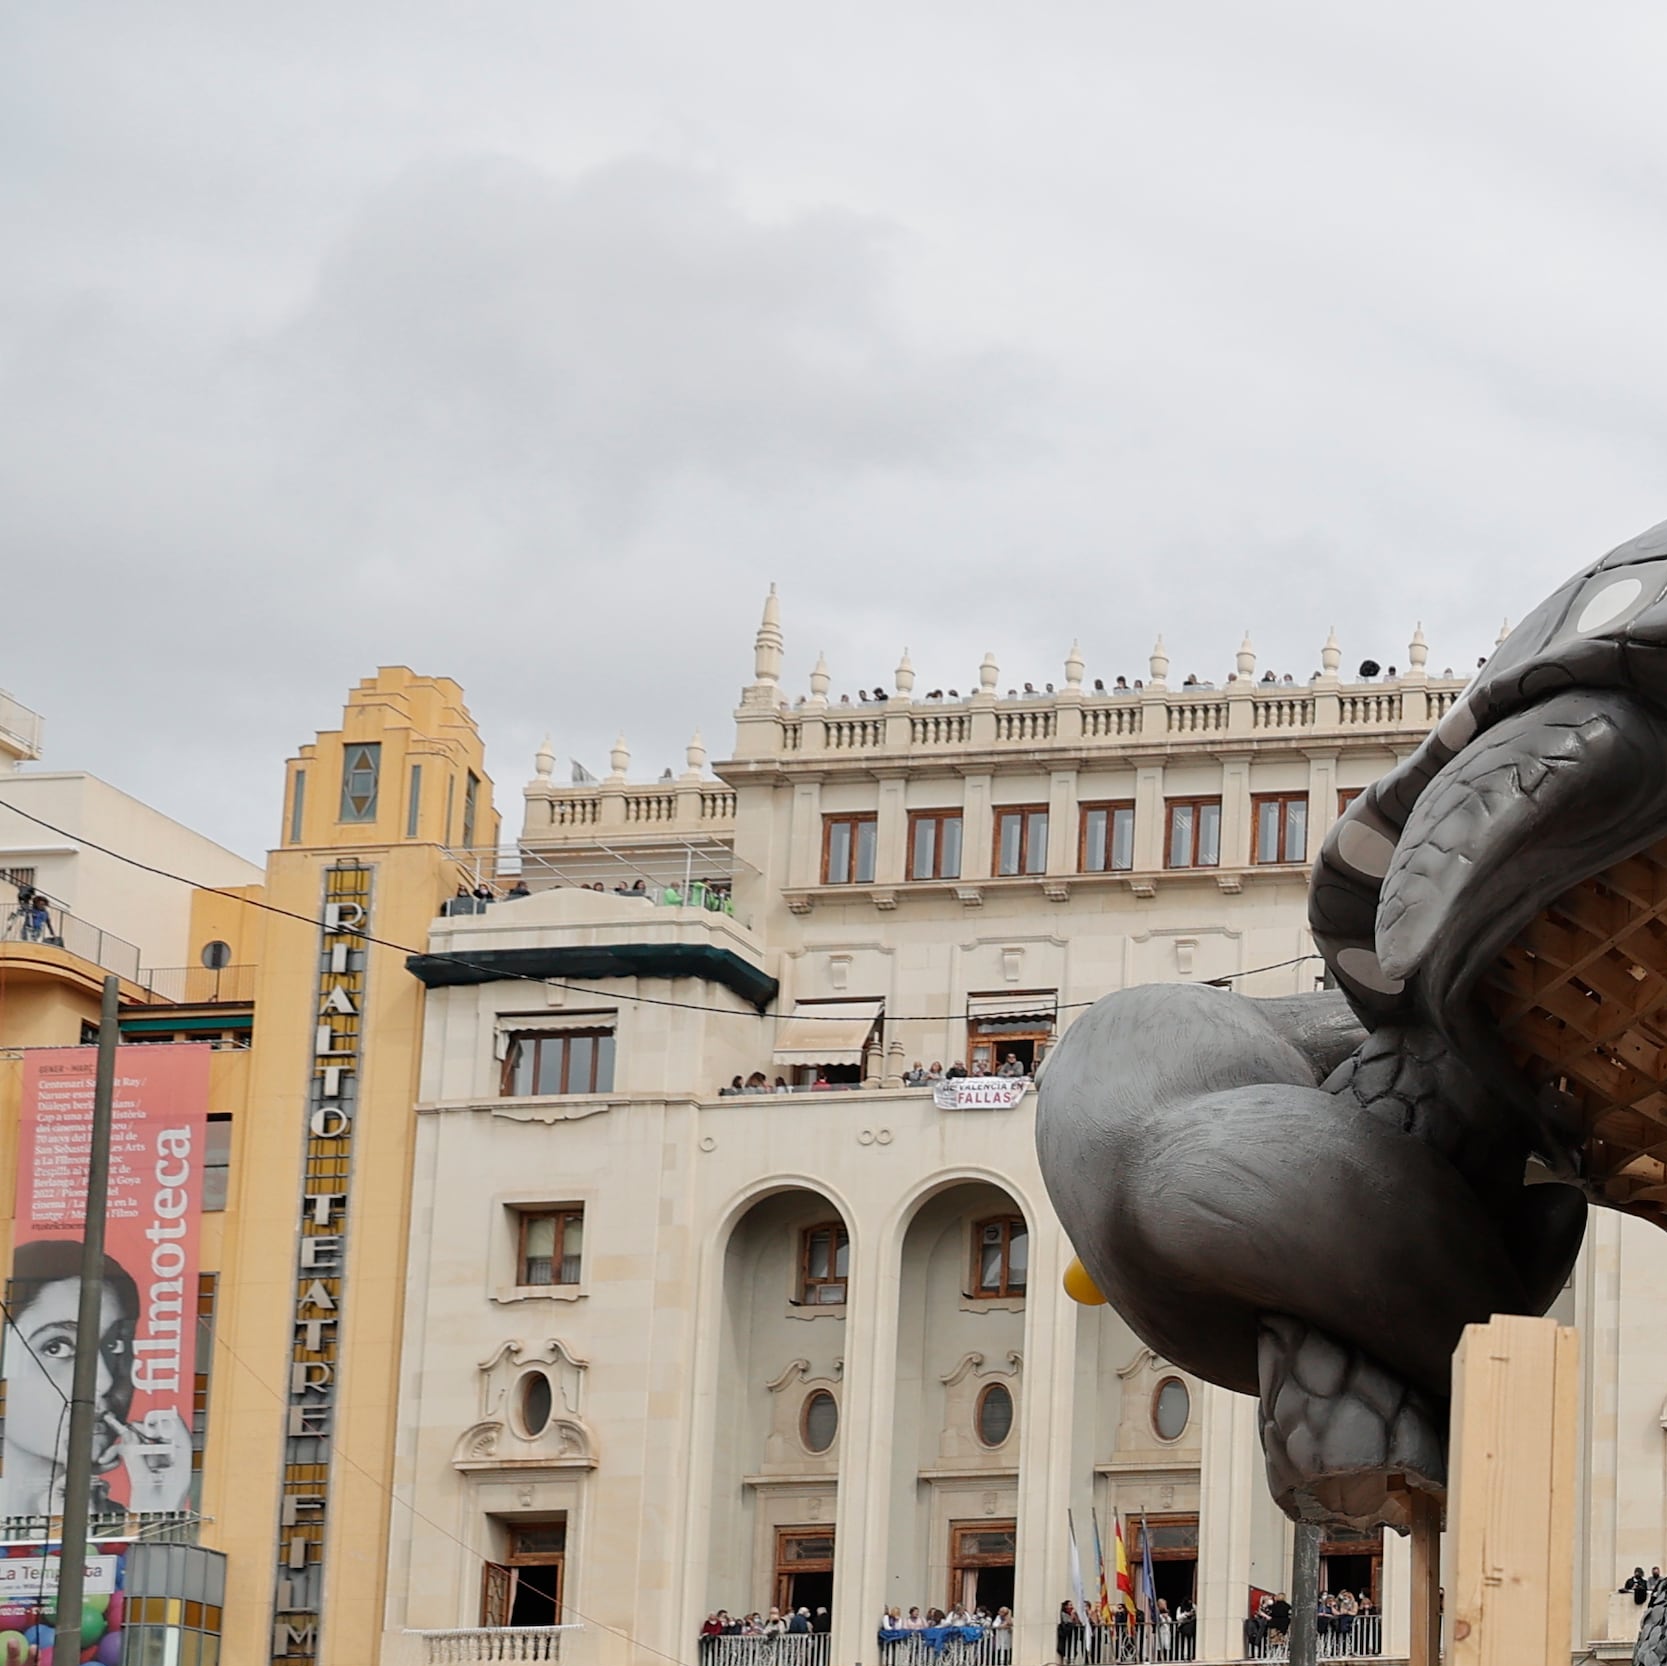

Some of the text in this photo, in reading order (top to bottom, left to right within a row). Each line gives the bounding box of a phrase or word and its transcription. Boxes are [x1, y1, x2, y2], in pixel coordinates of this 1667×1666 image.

[310, 901, 366, 1138] RIALTO
[958, 1091, 1012, 1104] FALLAS
[131, 1125, 191, 1394] filmoteca
[288, 1194, 344, 1437] TEATRE
